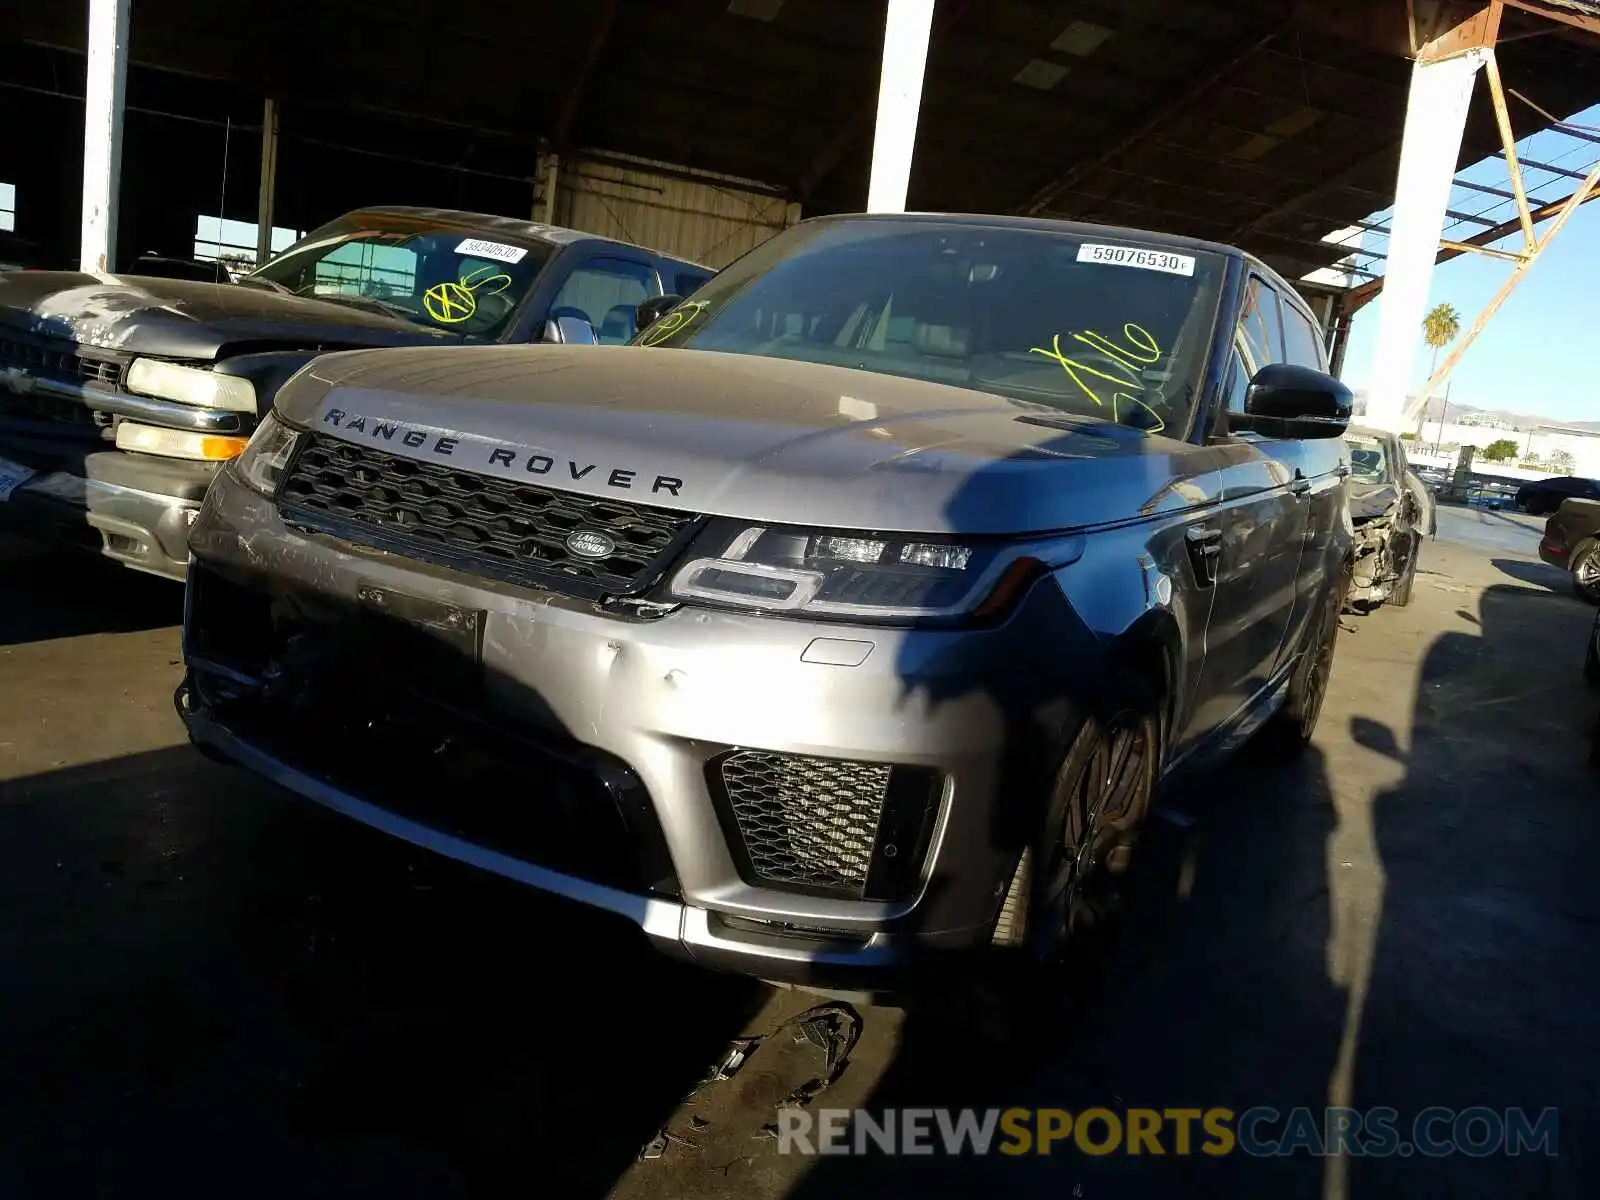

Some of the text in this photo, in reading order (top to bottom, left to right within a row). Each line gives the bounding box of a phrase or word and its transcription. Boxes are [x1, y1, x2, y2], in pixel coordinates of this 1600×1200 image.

[1093, 247, 1179, 270] 59076530
[323, 407, 684, 497] RANGE ROVER
[574, 540, 606, 553] ROVER
[575, 533, 602, 544] LAND
